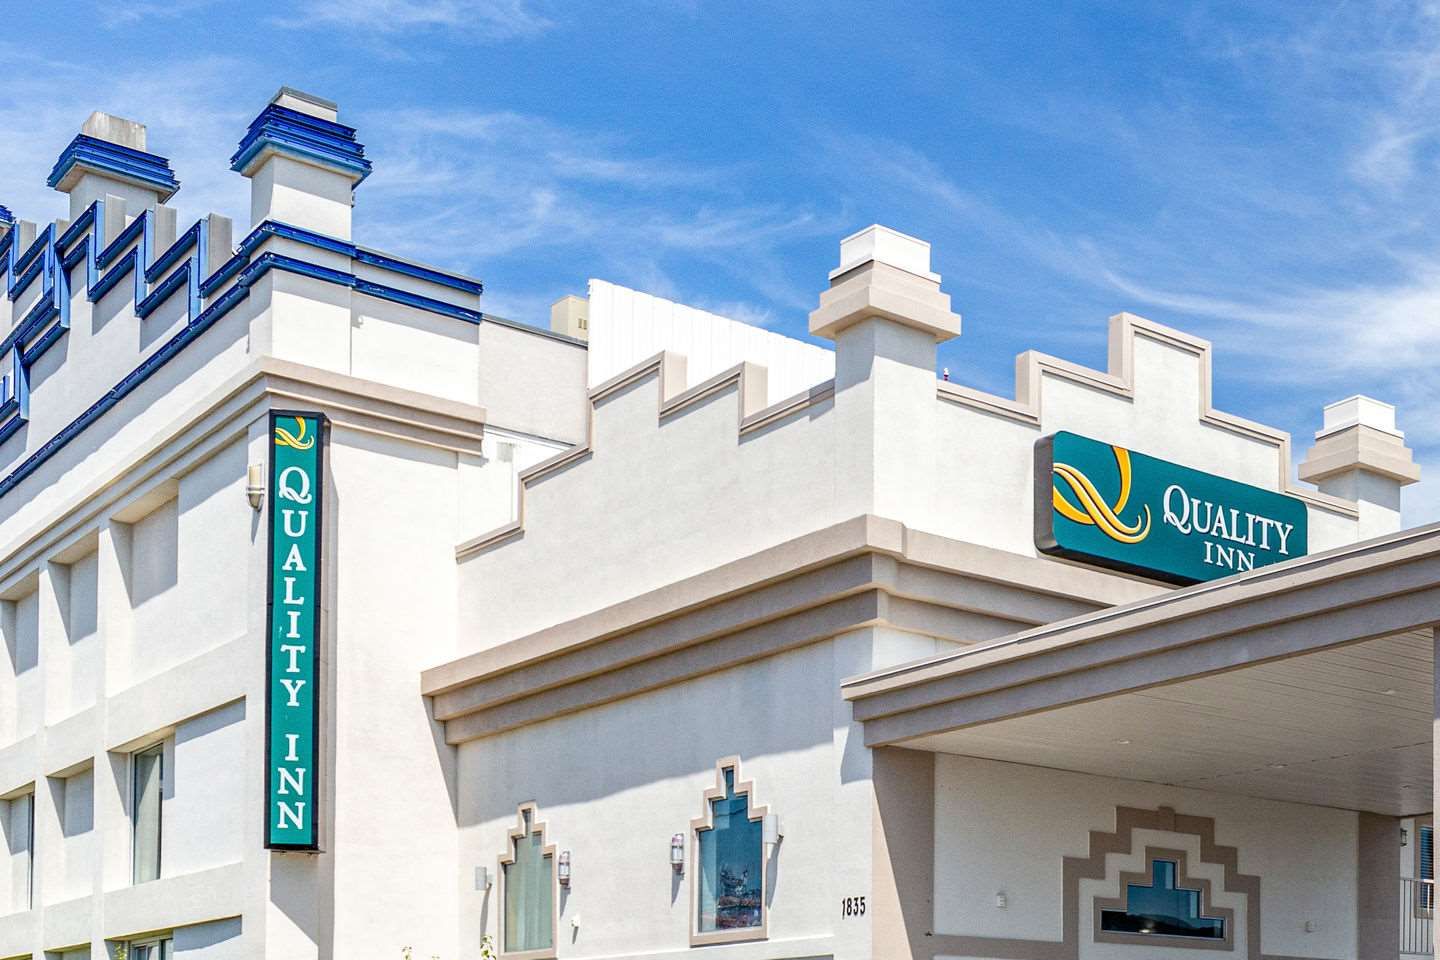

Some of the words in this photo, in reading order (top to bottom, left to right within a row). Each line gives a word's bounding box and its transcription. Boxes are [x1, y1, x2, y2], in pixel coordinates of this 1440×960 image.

[1163, 484, 1294, 556] QUALITY
[278, 466, 313, 707] QUALITY
[1203, 541, 1256, 573] INN
[277, 733, 307, 830] INN
[841, 896, 866, 920] 1835
